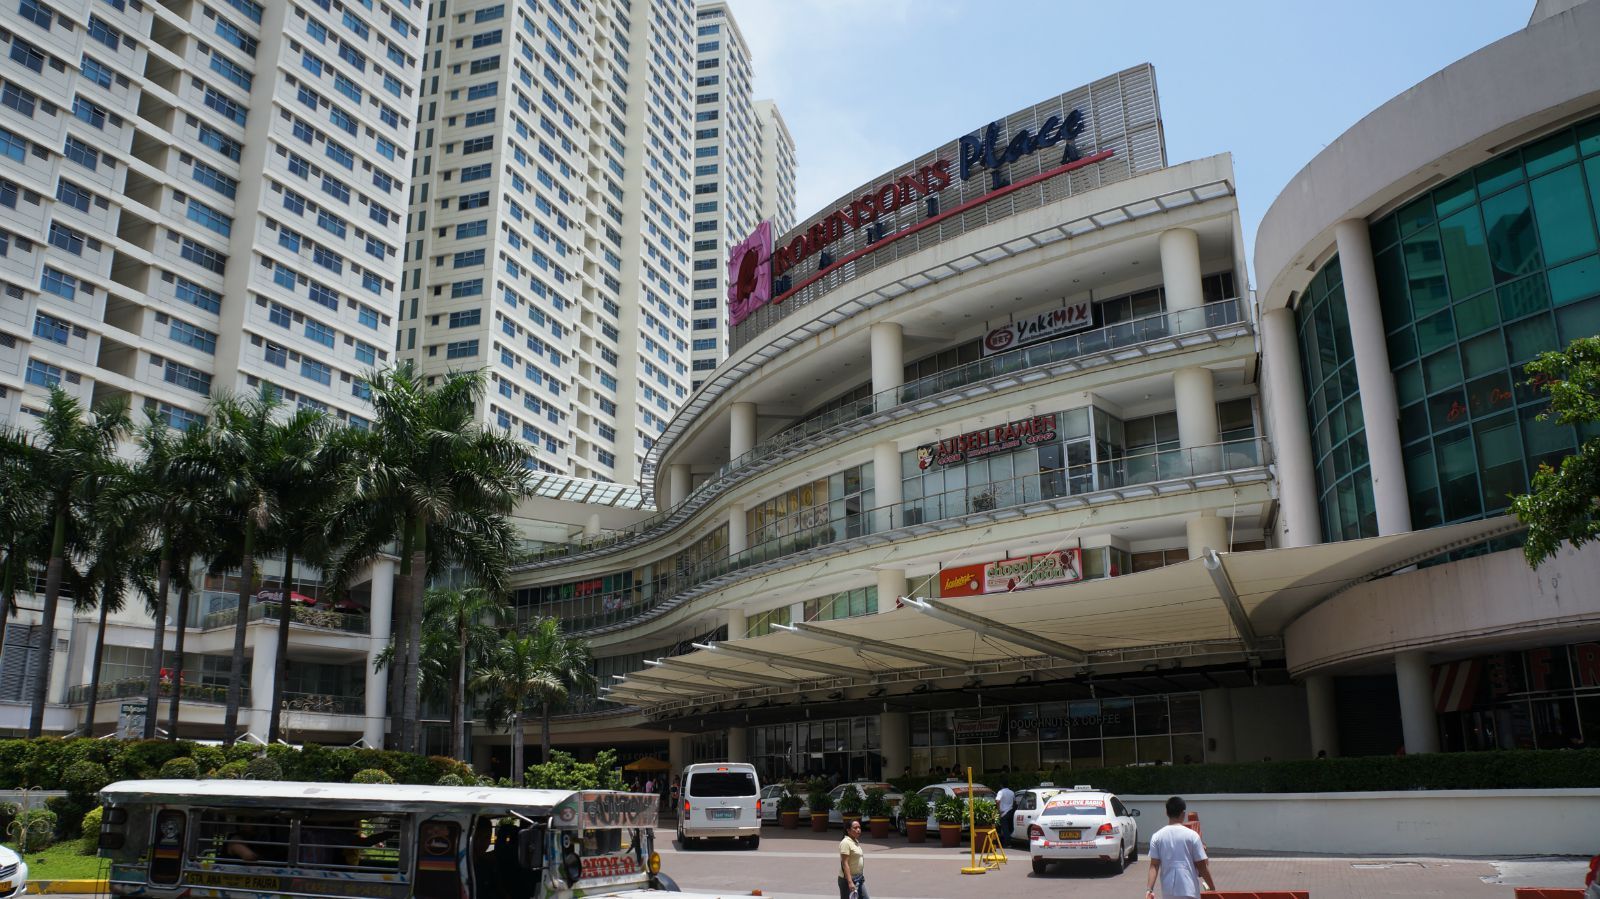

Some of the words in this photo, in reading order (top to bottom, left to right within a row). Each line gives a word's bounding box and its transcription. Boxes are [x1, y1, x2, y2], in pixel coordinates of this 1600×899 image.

[773, 158, 951, 275] ROBINSONS
[960, 109, 1085, 181] Place
[936, 430, 990, 457] AJISEN
[995, 414, 1057, 442] RAMEN
[1010, 717, 1071, 729] DOUGHNUTS
[1073, 718, 1080, 727] &
[1081, 713, 1121, 725] COFFEE
